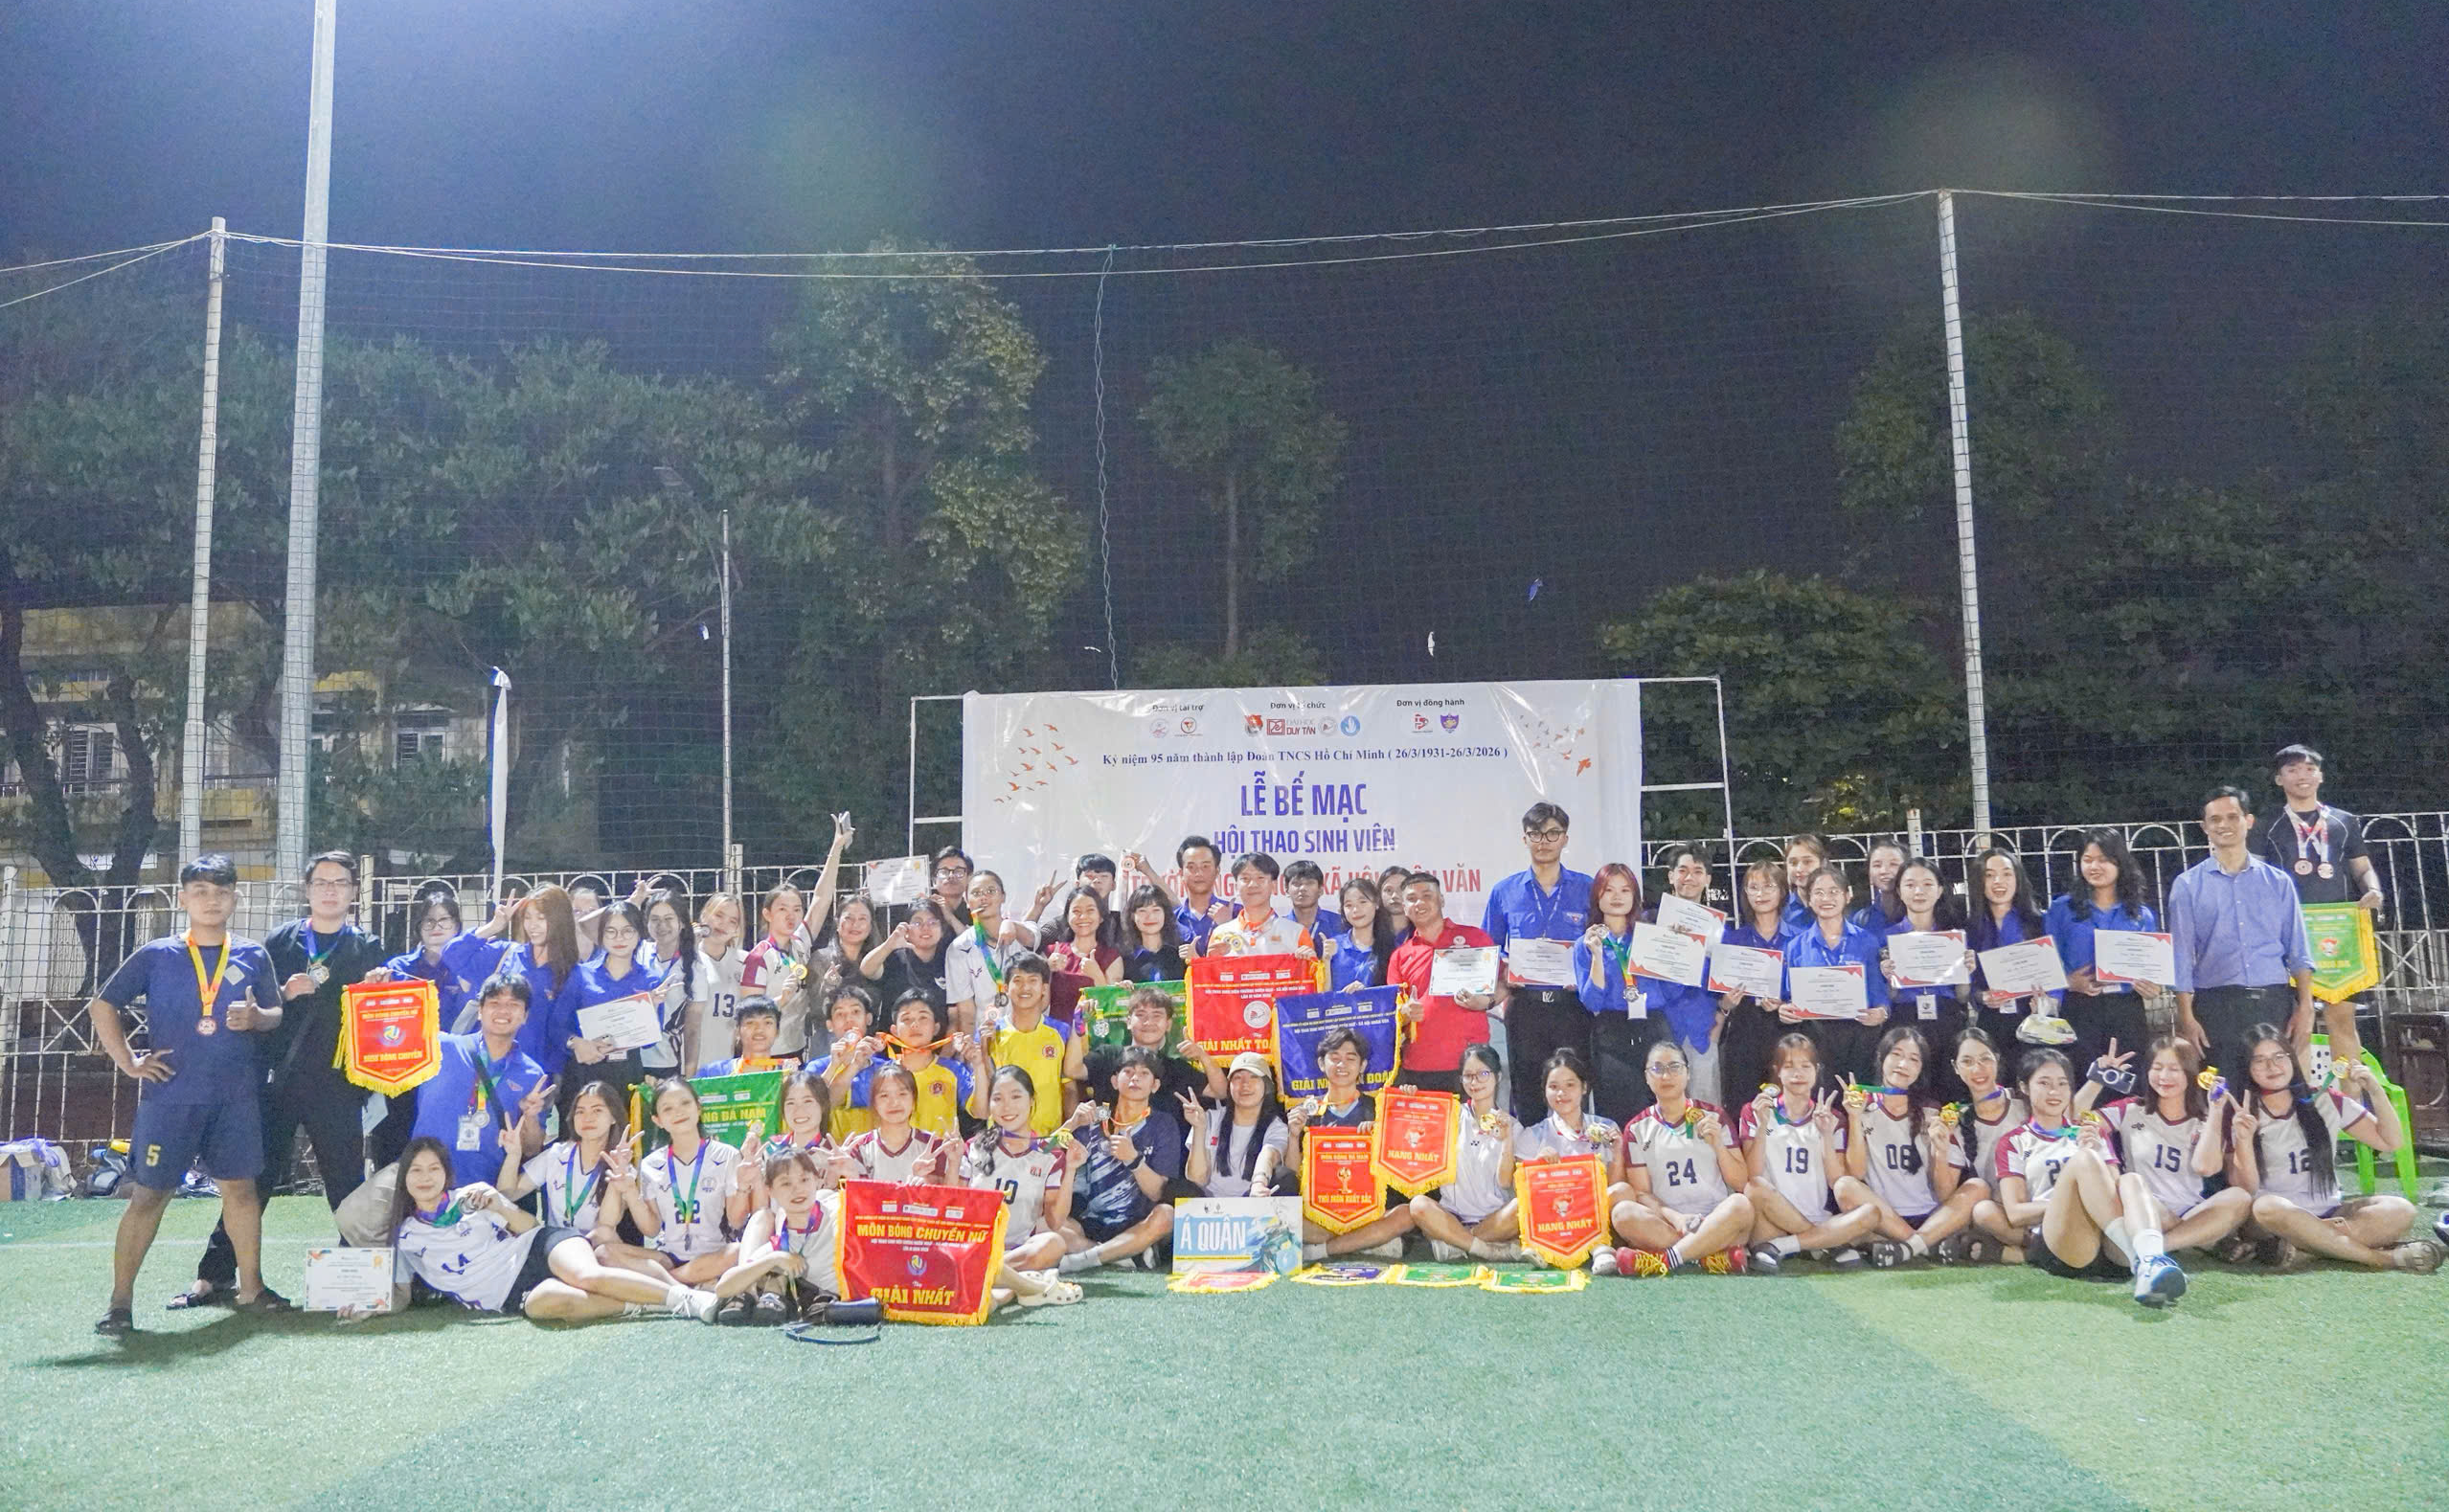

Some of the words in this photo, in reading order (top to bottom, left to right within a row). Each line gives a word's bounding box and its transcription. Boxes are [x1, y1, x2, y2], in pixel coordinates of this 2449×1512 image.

[1286, 727, 1301, 735] DUY
[1122, 754, 1147, 766] niệm
[1151, 754, 1163, 763] 95
[1167, 753, 1190, 762] năm
[1192, 752, 1224, 762] thành
[1227, 751, 1243, 764] lập
[1278, 750, 1311, 761] TNCS
[1314, 748, 1330, 760] Hồ
[1333, 749, 1352, 760] Chí
[1356, 748, 1385, 759] Minh
[1395, 746, 1501, 758] 26/3/1931-26/3/2026
[1241, 770, 1267, 816] LỄ
[1275, 770, 1304, 816] BẾ
[1311, 783, 1368, 824] MẠC
[1213, 824, 1245, 859] HỘI
[1250, 829, 1300, 854] THAO
[1304, 829, 1349, 853] SINH
[1353, 823, 1395, 853] VIÊN
[1441, 863, 1482, 892] VĂN
[713, 993, 736, 1017] 13
[1221, 1036, 1252, 1050] NHẤT
[1291, 1077, 1315, 1091] GIẢI
[739, 1107, 766, 1119] NAM
[146, 1144, 161, 1167] 5
[1785, 1147, 1809, 1174] 19
[2154, 1143, 2182, 1173] 15
[1666, 1158, 1698, 1186] 24
[857, 1222, 886, 1237] MÔN
[888, 1223, 913, 1238] BÓNG
[916, 1226, 965, 1243] CHUYỀN
[967, 1230, 988, 1243] NỮ
[1197, 1214, 1246, 1252] QUÂN
[871, 1284, 909, 1304] GIẢI
[912, 1284, 955, 1306] NHẤT
